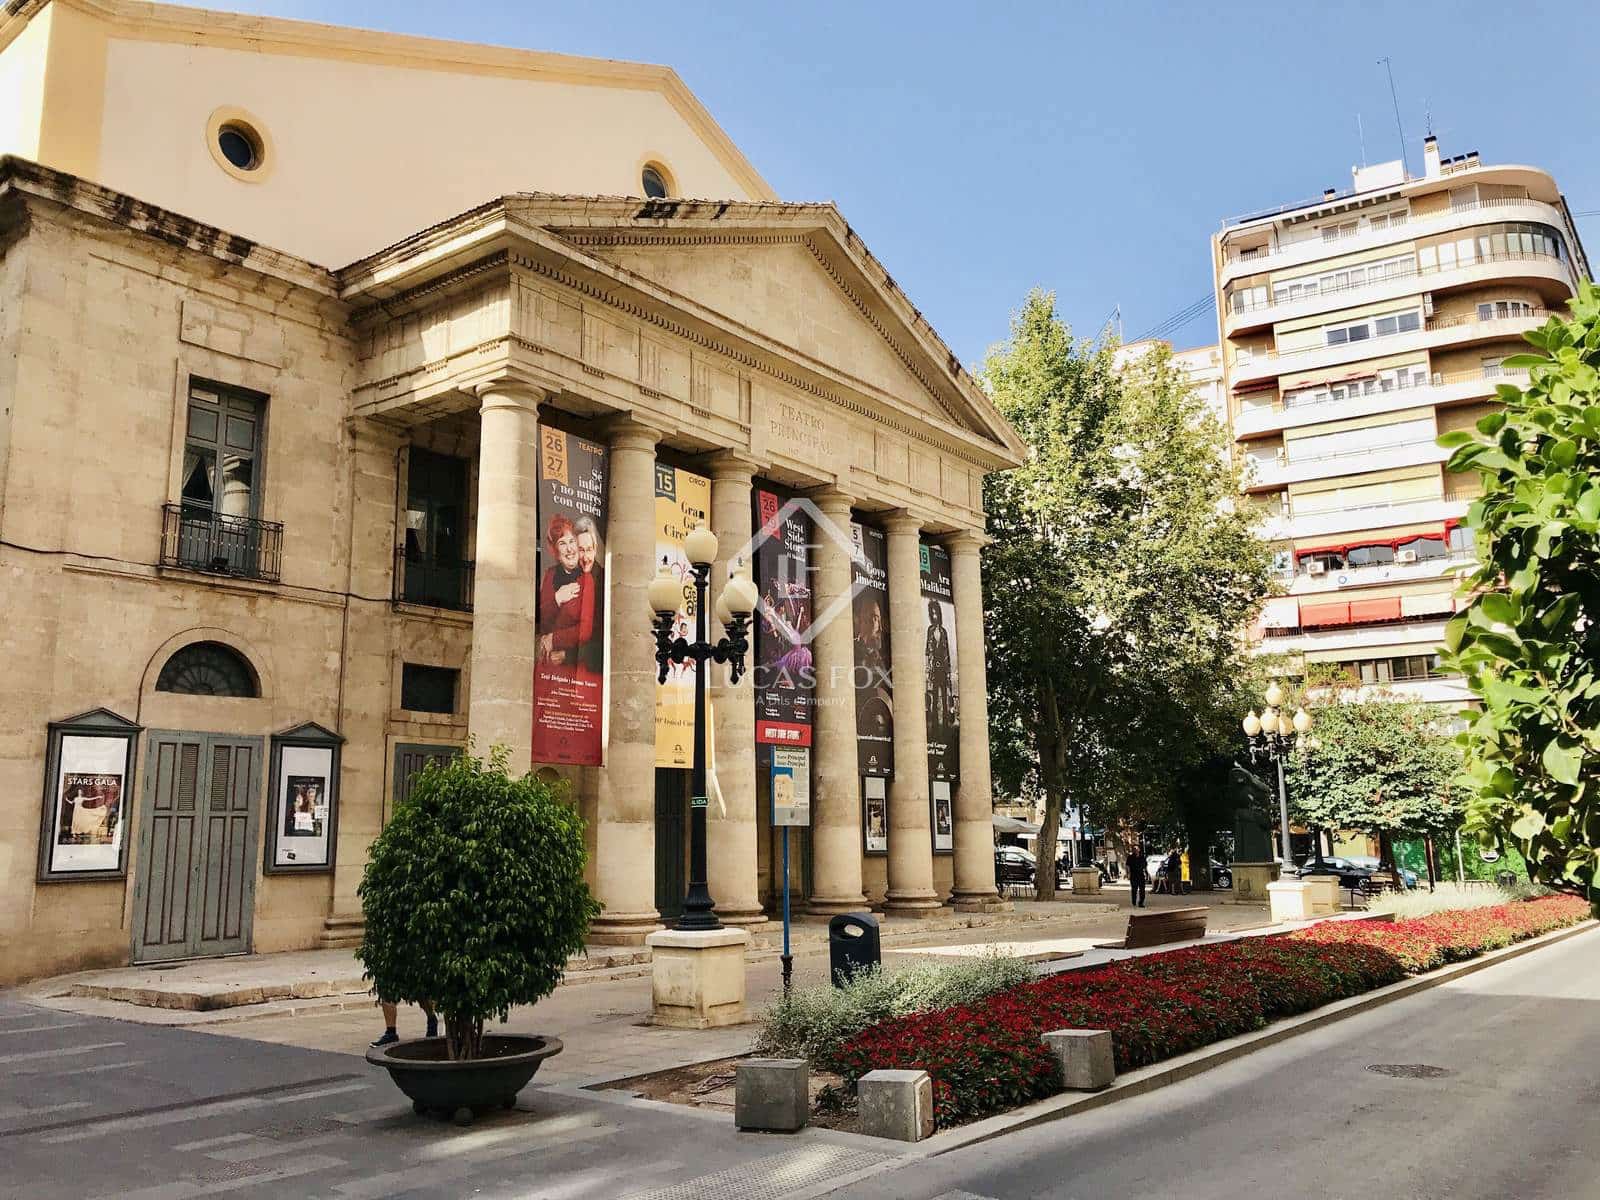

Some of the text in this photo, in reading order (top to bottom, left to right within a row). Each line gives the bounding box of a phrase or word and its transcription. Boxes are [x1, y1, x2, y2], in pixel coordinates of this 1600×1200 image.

[776, 401, 825, 432] TEATRO
[546, 435, 562, 452] 26
[771, 421, 833, 455] PRINCIPAL
[578, 441, 603, 456] TEATRO
[547, 456, 563, 472] 27
[578, 476, 602, 494] infiel
[657, 473, 673, 491] 15
[688, 477, 706, 487] CIRCO
[552, 482, 602, 505] y no mires
[553, 495, 601, 517] con quién
[763, 500, 775, 513] 26
[785, 517, 804, 534] West
[787, 529, 804, 544] Side
[784, 538, 804, 553] Story
[866, 560, 886, 579] Goyo
[938, 572, 951, 586] Ara
[920, 579, 951, 597] Malikian
[67, 777, 117, 786] STARS GALA
